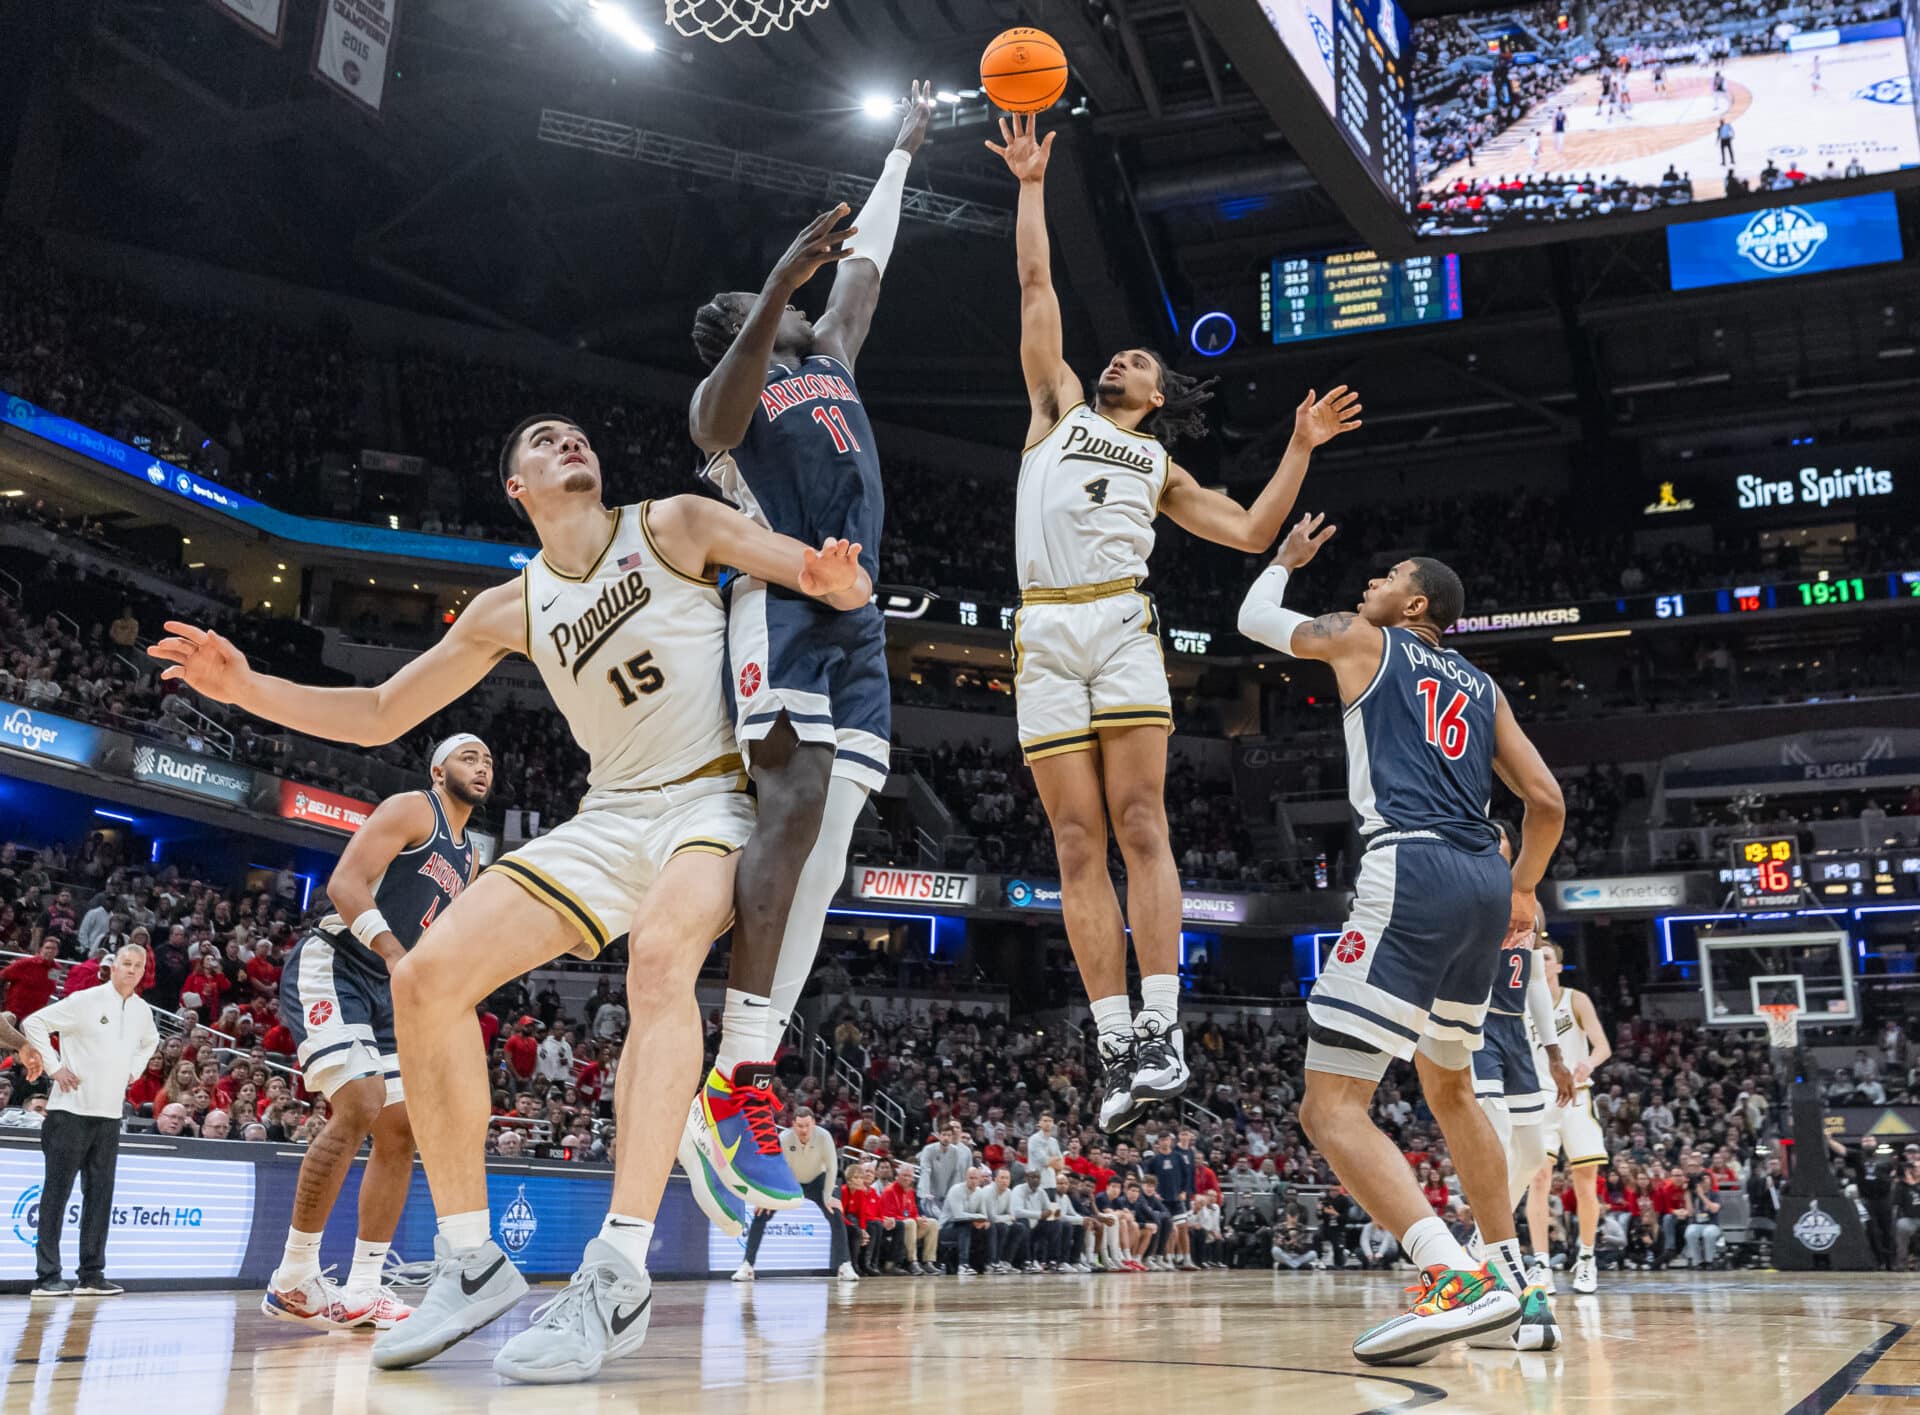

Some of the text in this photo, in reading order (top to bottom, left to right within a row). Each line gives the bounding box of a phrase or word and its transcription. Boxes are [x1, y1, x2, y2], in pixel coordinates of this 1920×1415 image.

[341, 30, 371, 62] 2015
[1284, 259, 1309, 272] 57.9
[1327, 250, 1379, 265] FIELD GOAL
[1284, 272, 1309, 285] 33.3
[1325, 267, 1348, 279] FREE
[1349, 263, 1381, 275] THROW
[1406, 267, 1432, 281] 75.0
[1284, 285, 1309, 297] 40.0
[1328, 279, 1365, 291] 3-POINT
[1261, 272, 1271, 332] PURDUE
[1333, 288, 1383, 304] REBOUNDS
[1339, 302, 1378, 316] ASSISTS
[1416, 307, 1426, 320] 7
[1331, 313, 1386, 330] TURNOVERS
[760, 373, 861, 423] ARIZONA
[811, 405, 861, 454] 11
[1060, 424, 1154, 475] Purdue
[1083, 477, 1110, 505] 4
[1736, 474, 1794, 509] Sire
[1800, 466, 1894, 507] Spirits
[1798, 578, 1865, 606] 19:11
[1655, 593, 1684, 618] 51
[1739, 595, 1761, 611] 16
[548, 571, 651, 668] Purdue
[960, 611, 978, 626] 18
[1456, 607, 1581, 633] BOILERMAKERS
[1174, 638, 1206, 654] 6/15
[607, 649, 665, 708] 15
[1400, 642, 1486, 700] JOHNSON
[1416, 677, 1470, 760] 16
[4, 709, 58, 750] Kroger
[157, 755, 250, 792] Ruoff MORTGAGE
[1804, 761, 1869, 779] FLIGHT
[307, 800, 341, 819] BELLE
[1744, 841, 1791, 862] 19:10
[1757, 860, 1790, 891] 16
[1824, 862, 1861, 879] 19:10
[861, 870, 969, 899] POINTSBET
[1035, 887, 1061, 901] Sport
[1609, 885, 1681, 899] Kinetico
[1183, 897, 1236, 912] DONUTS
[1758, 894, 1800, 906] TISSOT
[420, 895, 440, 930] 4
[1509, 954, 1523, 988] 2
[68, 1205, 203, 1229] Sts Tech HQ
[1467, 1295, 1501, 1317] Showtime
